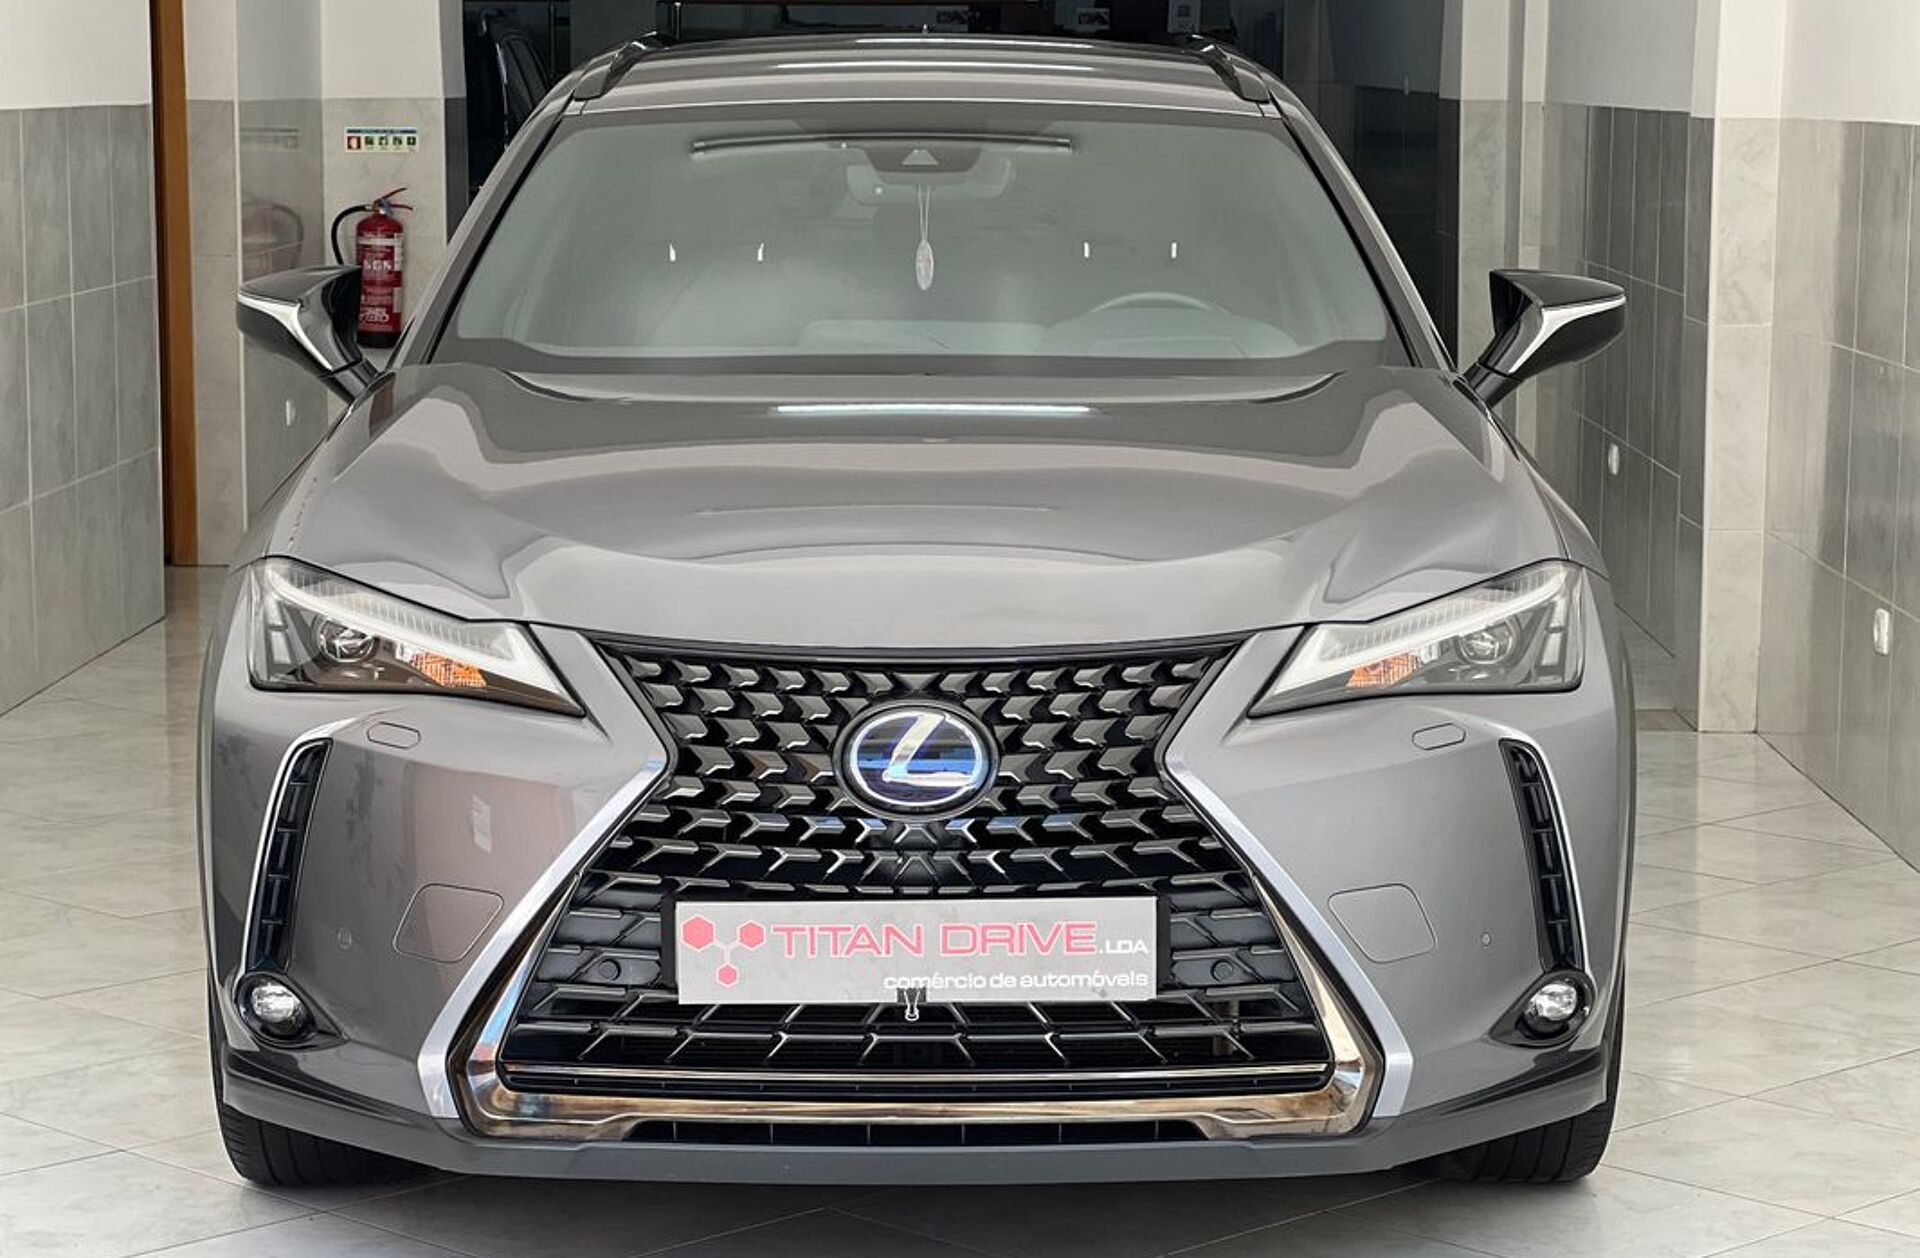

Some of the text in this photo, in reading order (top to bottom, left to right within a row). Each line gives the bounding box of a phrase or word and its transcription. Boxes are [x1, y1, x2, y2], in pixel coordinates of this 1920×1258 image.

[771, 924, 923, 957] TITAN
[939, 921, 1097, 956] DRIVE
[883, 969, 1149, 989] comércio de automóveis
